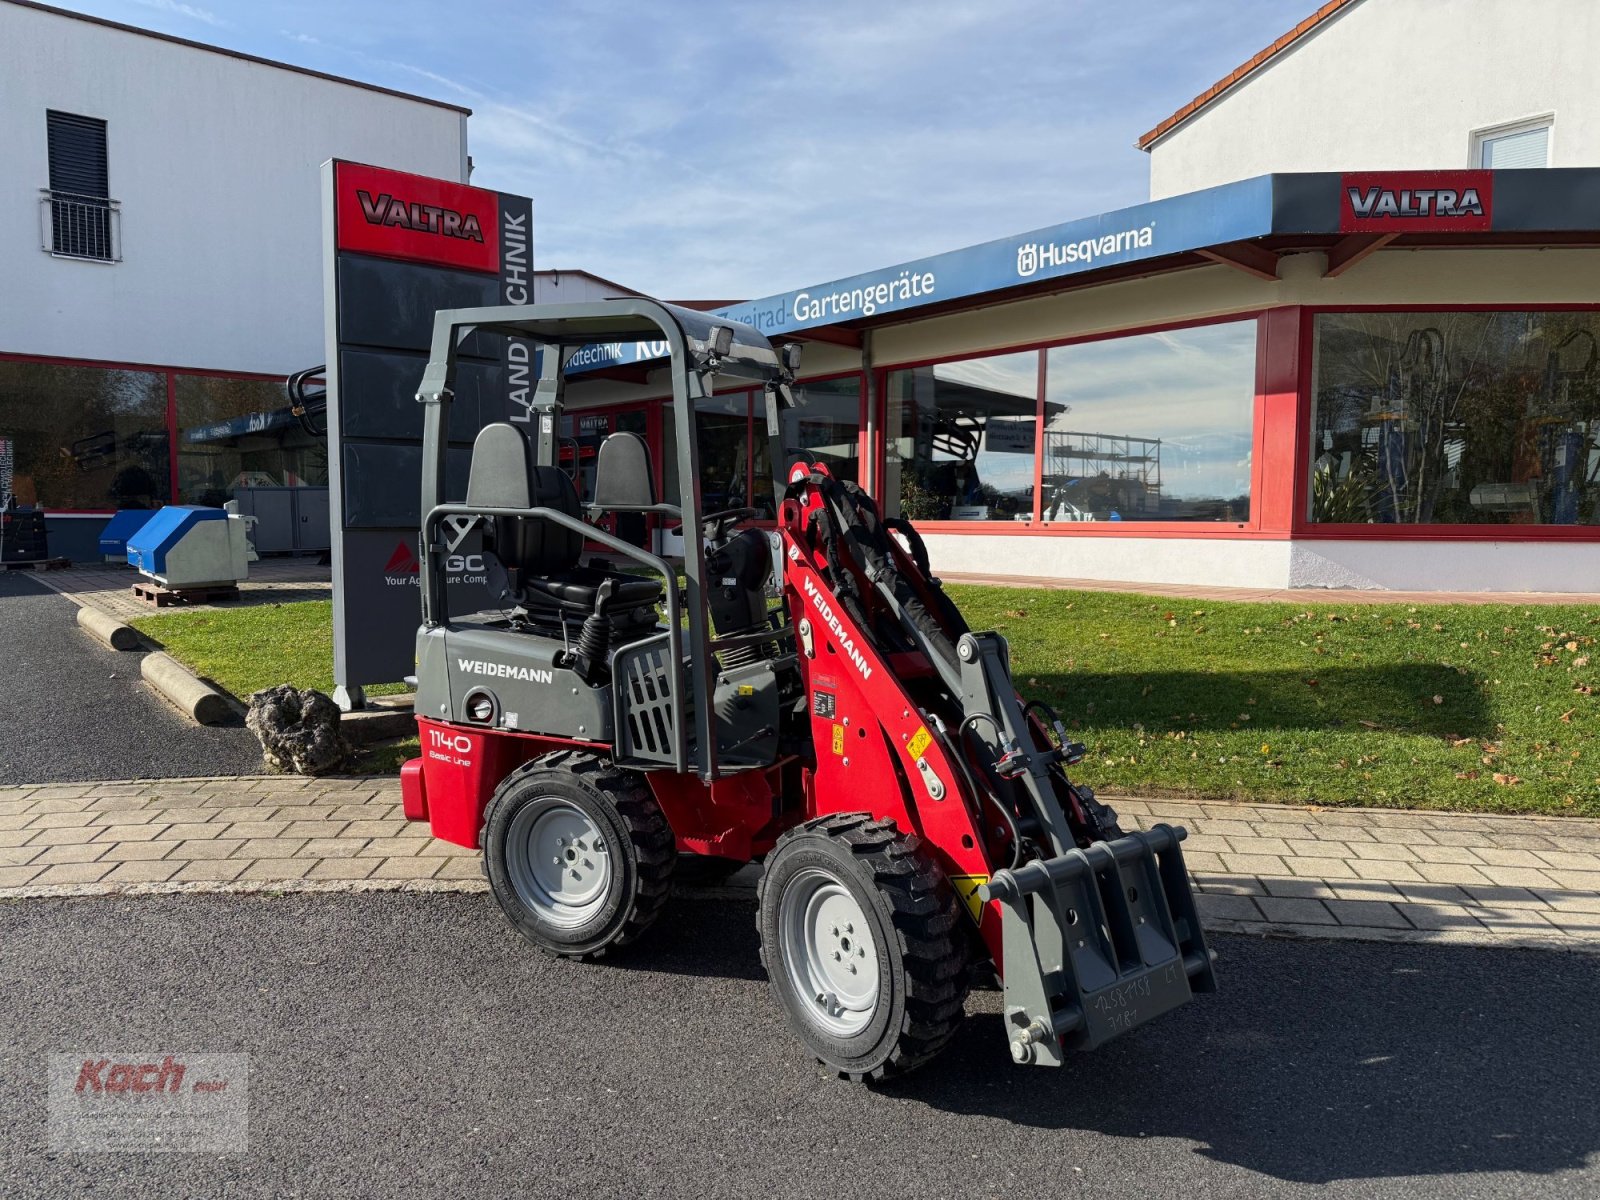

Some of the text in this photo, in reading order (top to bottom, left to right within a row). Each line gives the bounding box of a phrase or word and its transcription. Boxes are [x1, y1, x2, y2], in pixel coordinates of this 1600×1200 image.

[356, 190, 484, 243] VALTRA
[1347, 186, 1485, 218] VALTRA
[1040, 226, 1153, 269] Husqvarna
[504, 211, 530, 422] LANDCHNIK
[793, 270, 935, 321] Gartengeräte
[385, 576, 407, 586] Your
[463, 574, 488, 585] Comp
[804, 575, 873, 681] WEIDEMANN
[458, 658, 554, 685] WEIDEMANN
[429, 729, 473, 754] 1140
